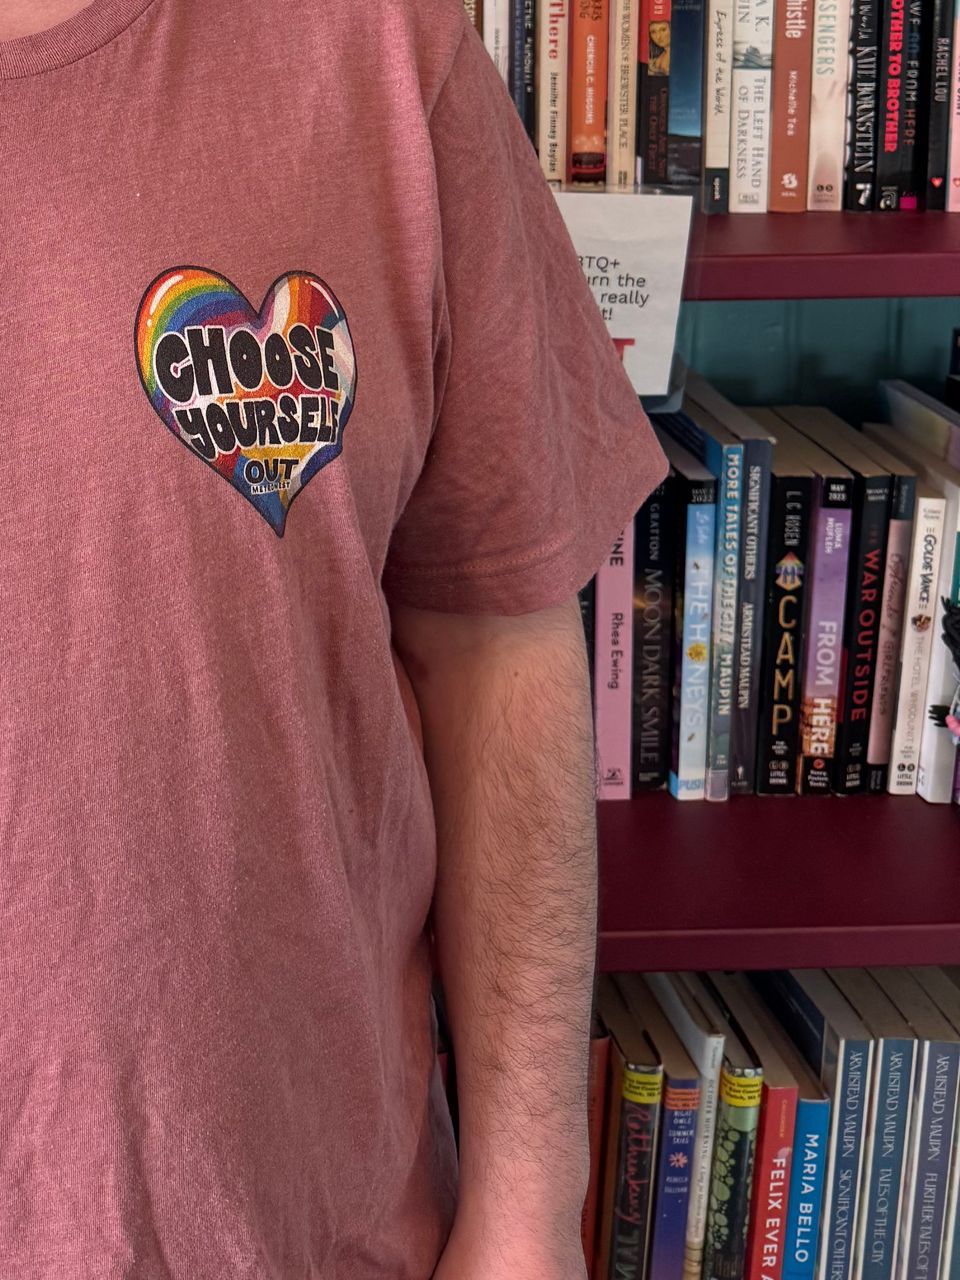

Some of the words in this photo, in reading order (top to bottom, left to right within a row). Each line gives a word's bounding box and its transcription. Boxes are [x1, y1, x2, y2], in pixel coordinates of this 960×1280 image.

[619, 12, 632, 51] WOMEN
[620, 52, 630, 62] OF
[549, 71, 560, 108] Jennifer
[618, 63, 632, 116] BREWSTER
[738, 86, 751, 104] OF
[753, 76, 769, 105] THE
[786, 69, 799, 115] Michelle
[546, 109, 559, 141] Finney
[617, 117, 630, 150] PLACE
[736, 109, 751, 180] DARKNESS
[752, 109, 768, 142] LEFT
[786, 117, 797, 137] Tea
[547, 142, 558, 174] Boylan
[750, 146, 767, 189] HAND
[600, 290, 650, 308] really
[617, 273, 646, 288] the
[154, 322, 339, 404] CHOOSE
[173, 394, 341, 461] YOURSELF
[244, 458, 300, 484] OUT
[649, 503, 660, 560] GRATTON
[690, 558, 711, 617] THE
[862, 548, 882, 602] WAR
[642, 568, 664, 639] MOON
[610, 612, 624, 646] Rhea
[606, 649, 623, 690] Ewing
[640, 645, 662, 701] DARK
[683, 623, 708, 727] HONEYS
[772, 595, 798, 736] CAMP
[814, 621, 839, 686] FROM
[850, 607, 875, 722] OUTSIDE
[639, 706, 660, 763] SMILE
[810, 697, 834, 757] HERE
[883, 1051, 904, 1112] ARMISTEAD
[929, 1055, 951, 1115] ARMISTEAD
[880, 1114, 899, 1159] MAUPIN
[926, 1117, 945, 1162] MAUPIN
[800, 1133, 821, 1195] MARIA
[875, 1168, 894, 1197] TALES
[876, 1197, 889, 1213] OF
[919, 1172, 939, 1224] FURTHER
[794, 1202, 814, 1263] BELLO
[873, 1214, 887, 1241] THE
[916, 1225, 934, 1254] TALES
[870, 1241, 884, 1266] CITY
[915, 1254, 929, 1273] OF
